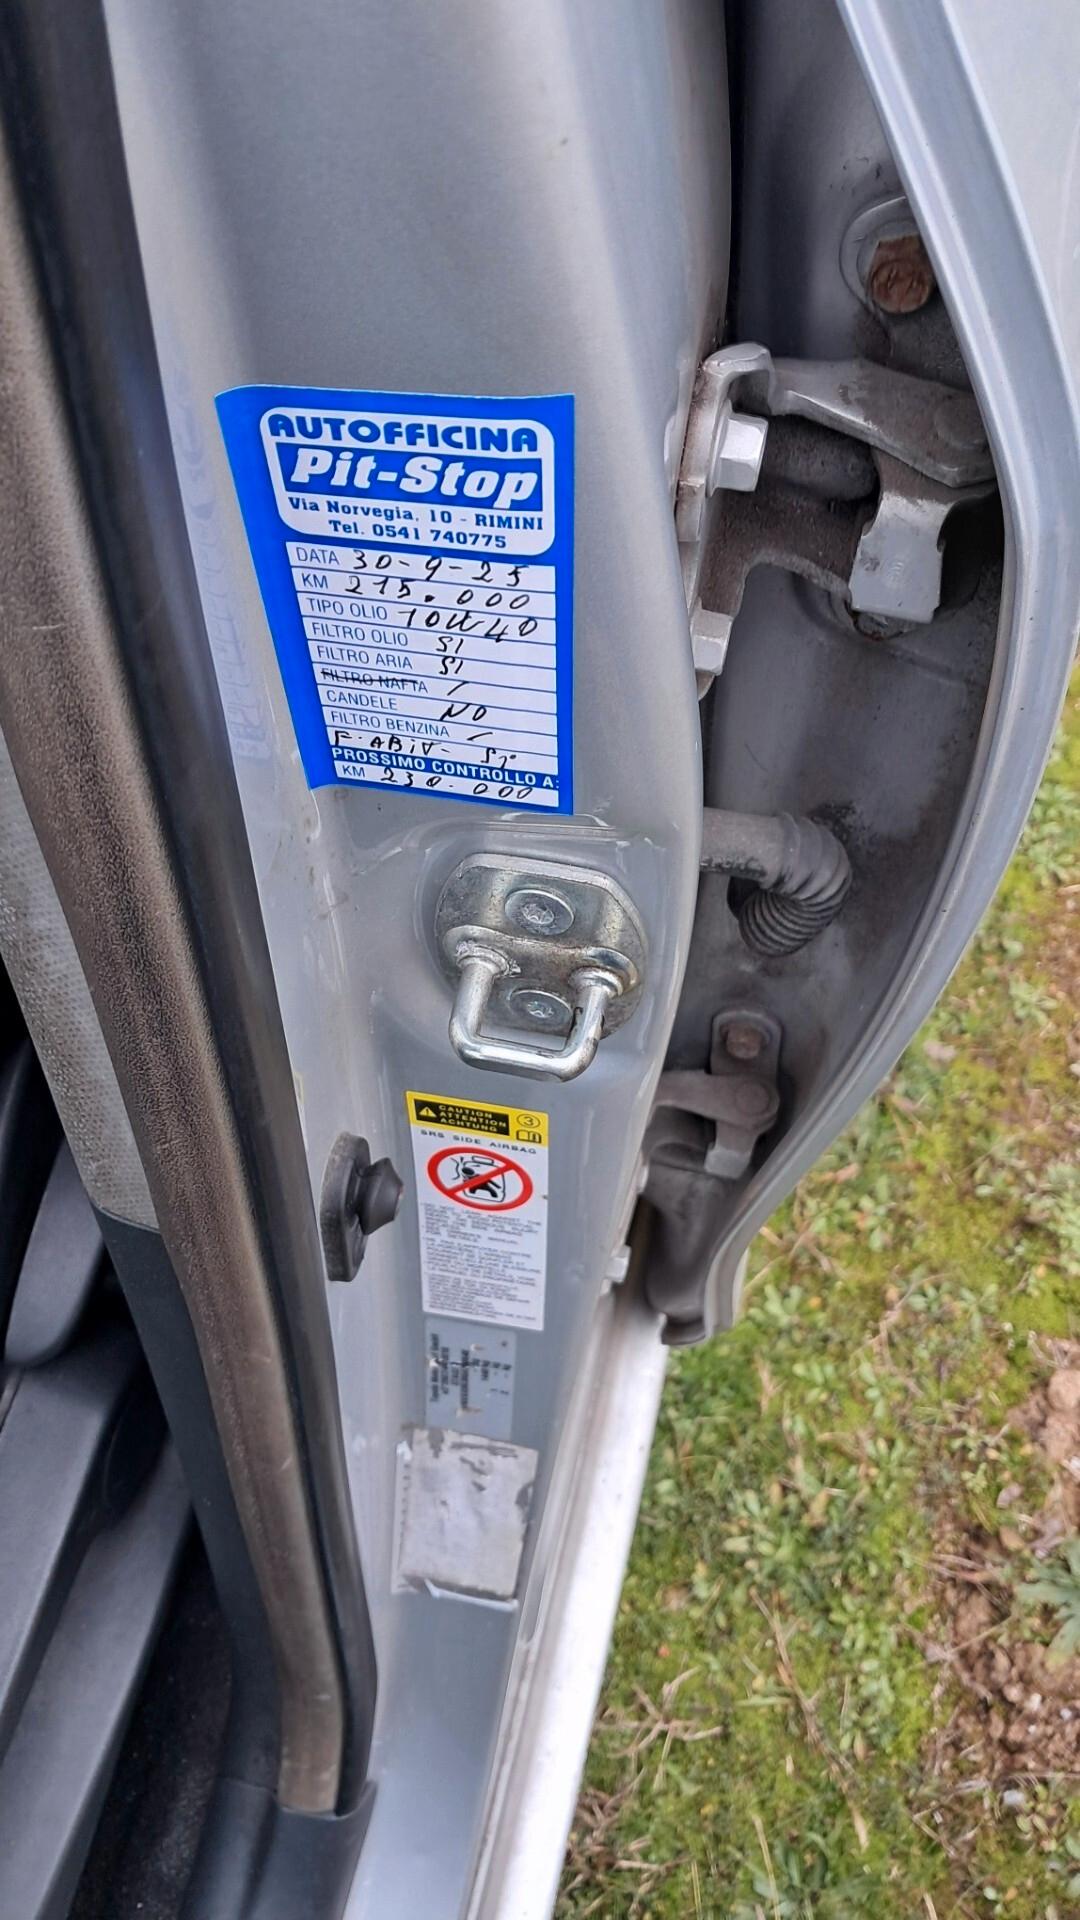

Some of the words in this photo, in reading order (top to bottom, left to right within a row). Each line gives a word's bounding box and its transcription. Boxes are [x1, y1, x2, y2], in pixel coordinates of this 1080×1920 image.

[267, 413, 538, 452] AUTOFFICINA
[290, 447, 539, 510] Pit-Stop
[288, 496, 320, 512] Via
[429, 510, 452, 525] 10
[474, 513, 544, 531] RIMINI
[328, 519, 366, 536] Tel.
[372, 525, 421, 540] 0541
[430, 529, 507, 548] 740775
[296, 547, 340, 565] DATA
[302, 573, 329, 589] KM
[306, 597, 345, 616] TIPO
[350, 603, 388, 620] OLIO
[312, 622, 366, 641] FILTRO
[371, 629, 409, 647] OLIO
[317, 645, 370, 665] FILTRO
[375, 653, 413, 670] ARIA
[327, 690, 398, 711] CANDELE
[331, 711, 381, 729] FILTRO
[387, 718, 450, 738] BENZINA
[333, 748, 426, 770] PROSSIMO
[432, 759, 536, 786] CONTROLLO
[542, 777, 561, 789] A:
[341, 765, 366, 779] KM
[438, 1104, 493, 1120] CAUTION
[440, 1111, 507, 1128] ATTENTION
[440, 1118, 498, 1133] ACHTUNG
[420, 1129, 445, 1139] SRS
[452, 1134, 482, 1145] SIDE
[489, 1141, 537, 1155] AIRBAG
